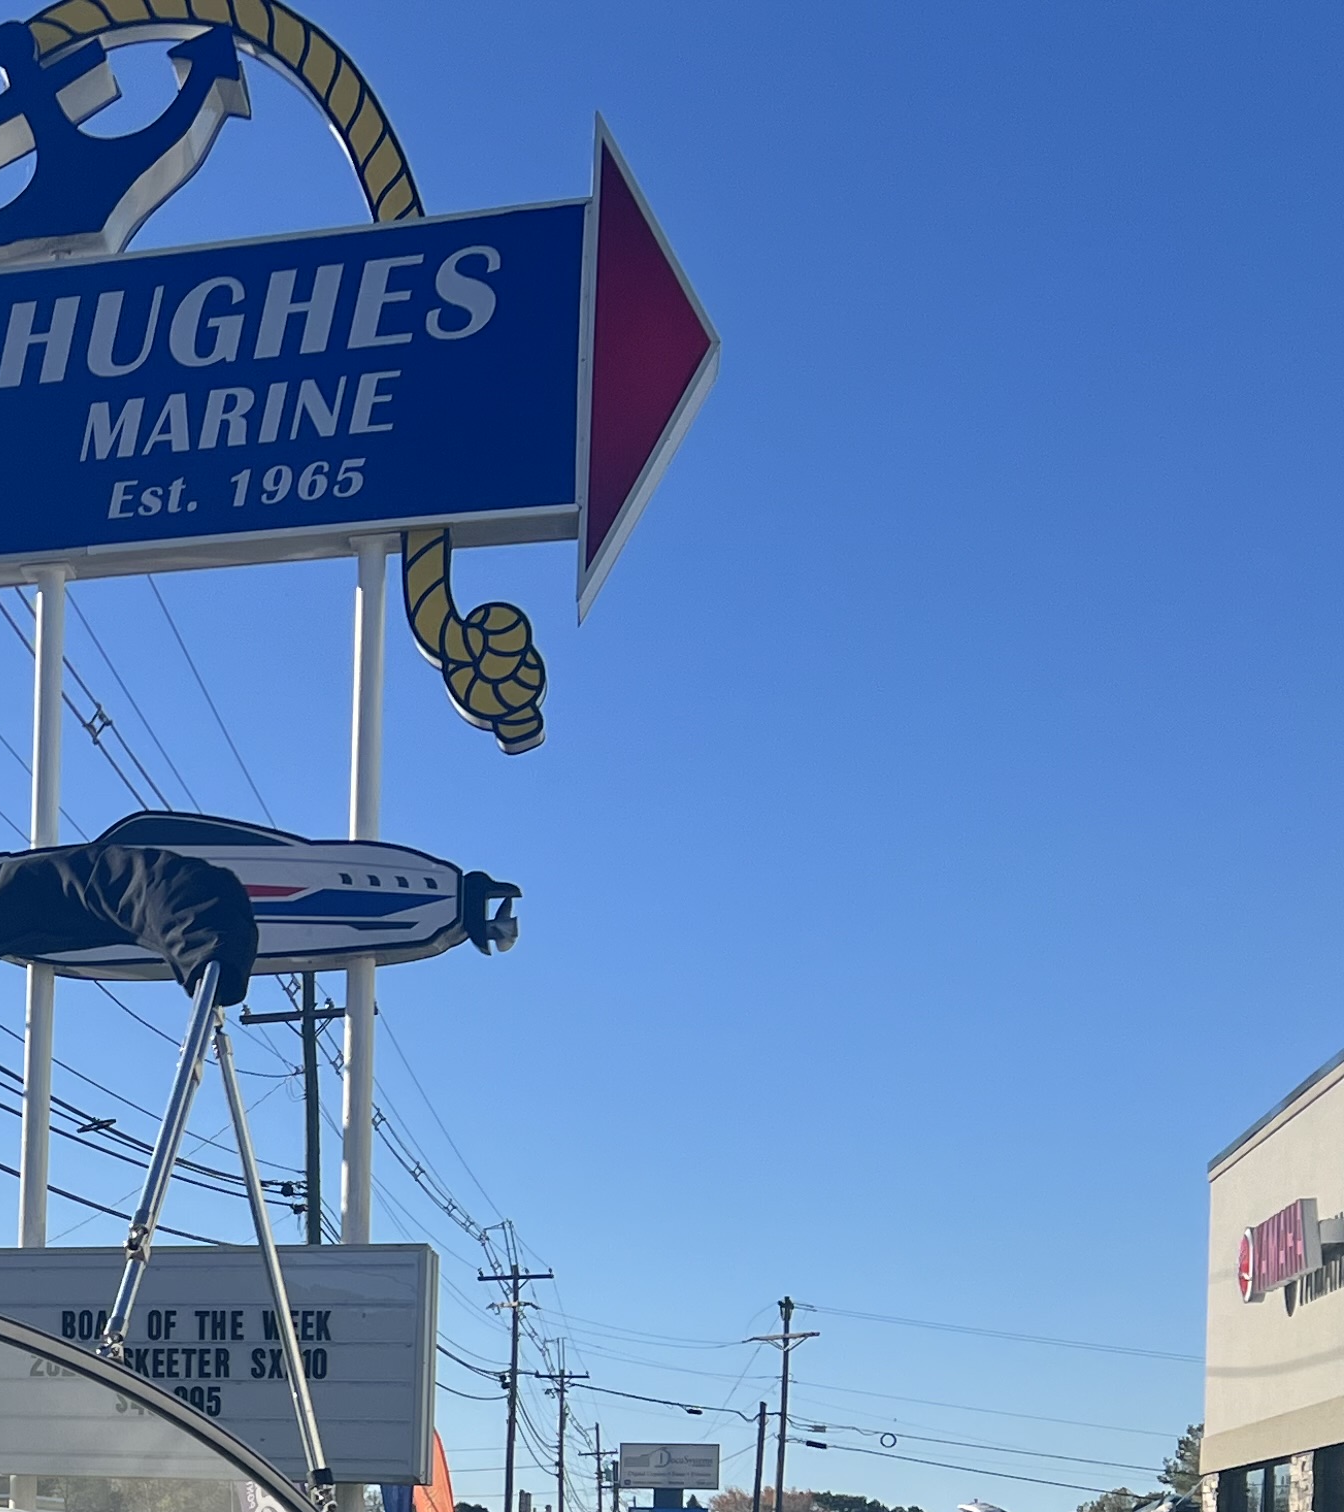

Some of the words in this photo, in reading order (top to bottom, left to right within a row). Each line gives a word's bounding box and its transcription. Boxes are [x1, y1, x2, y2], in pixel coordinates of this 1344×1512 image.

[79, 370, 402, 462] MARINE
[107, 477, 199, 520] Est.
[230, 457, 367, 508] 1965
[62, 1310, 107, 1340] BOA
[148, 1310, 177, 1341] OF
[194, 1310, 244, 1341] THE
[124, 1348, 230, 1378] SKEETER
[250, 1348, 328, 1379] SX10
